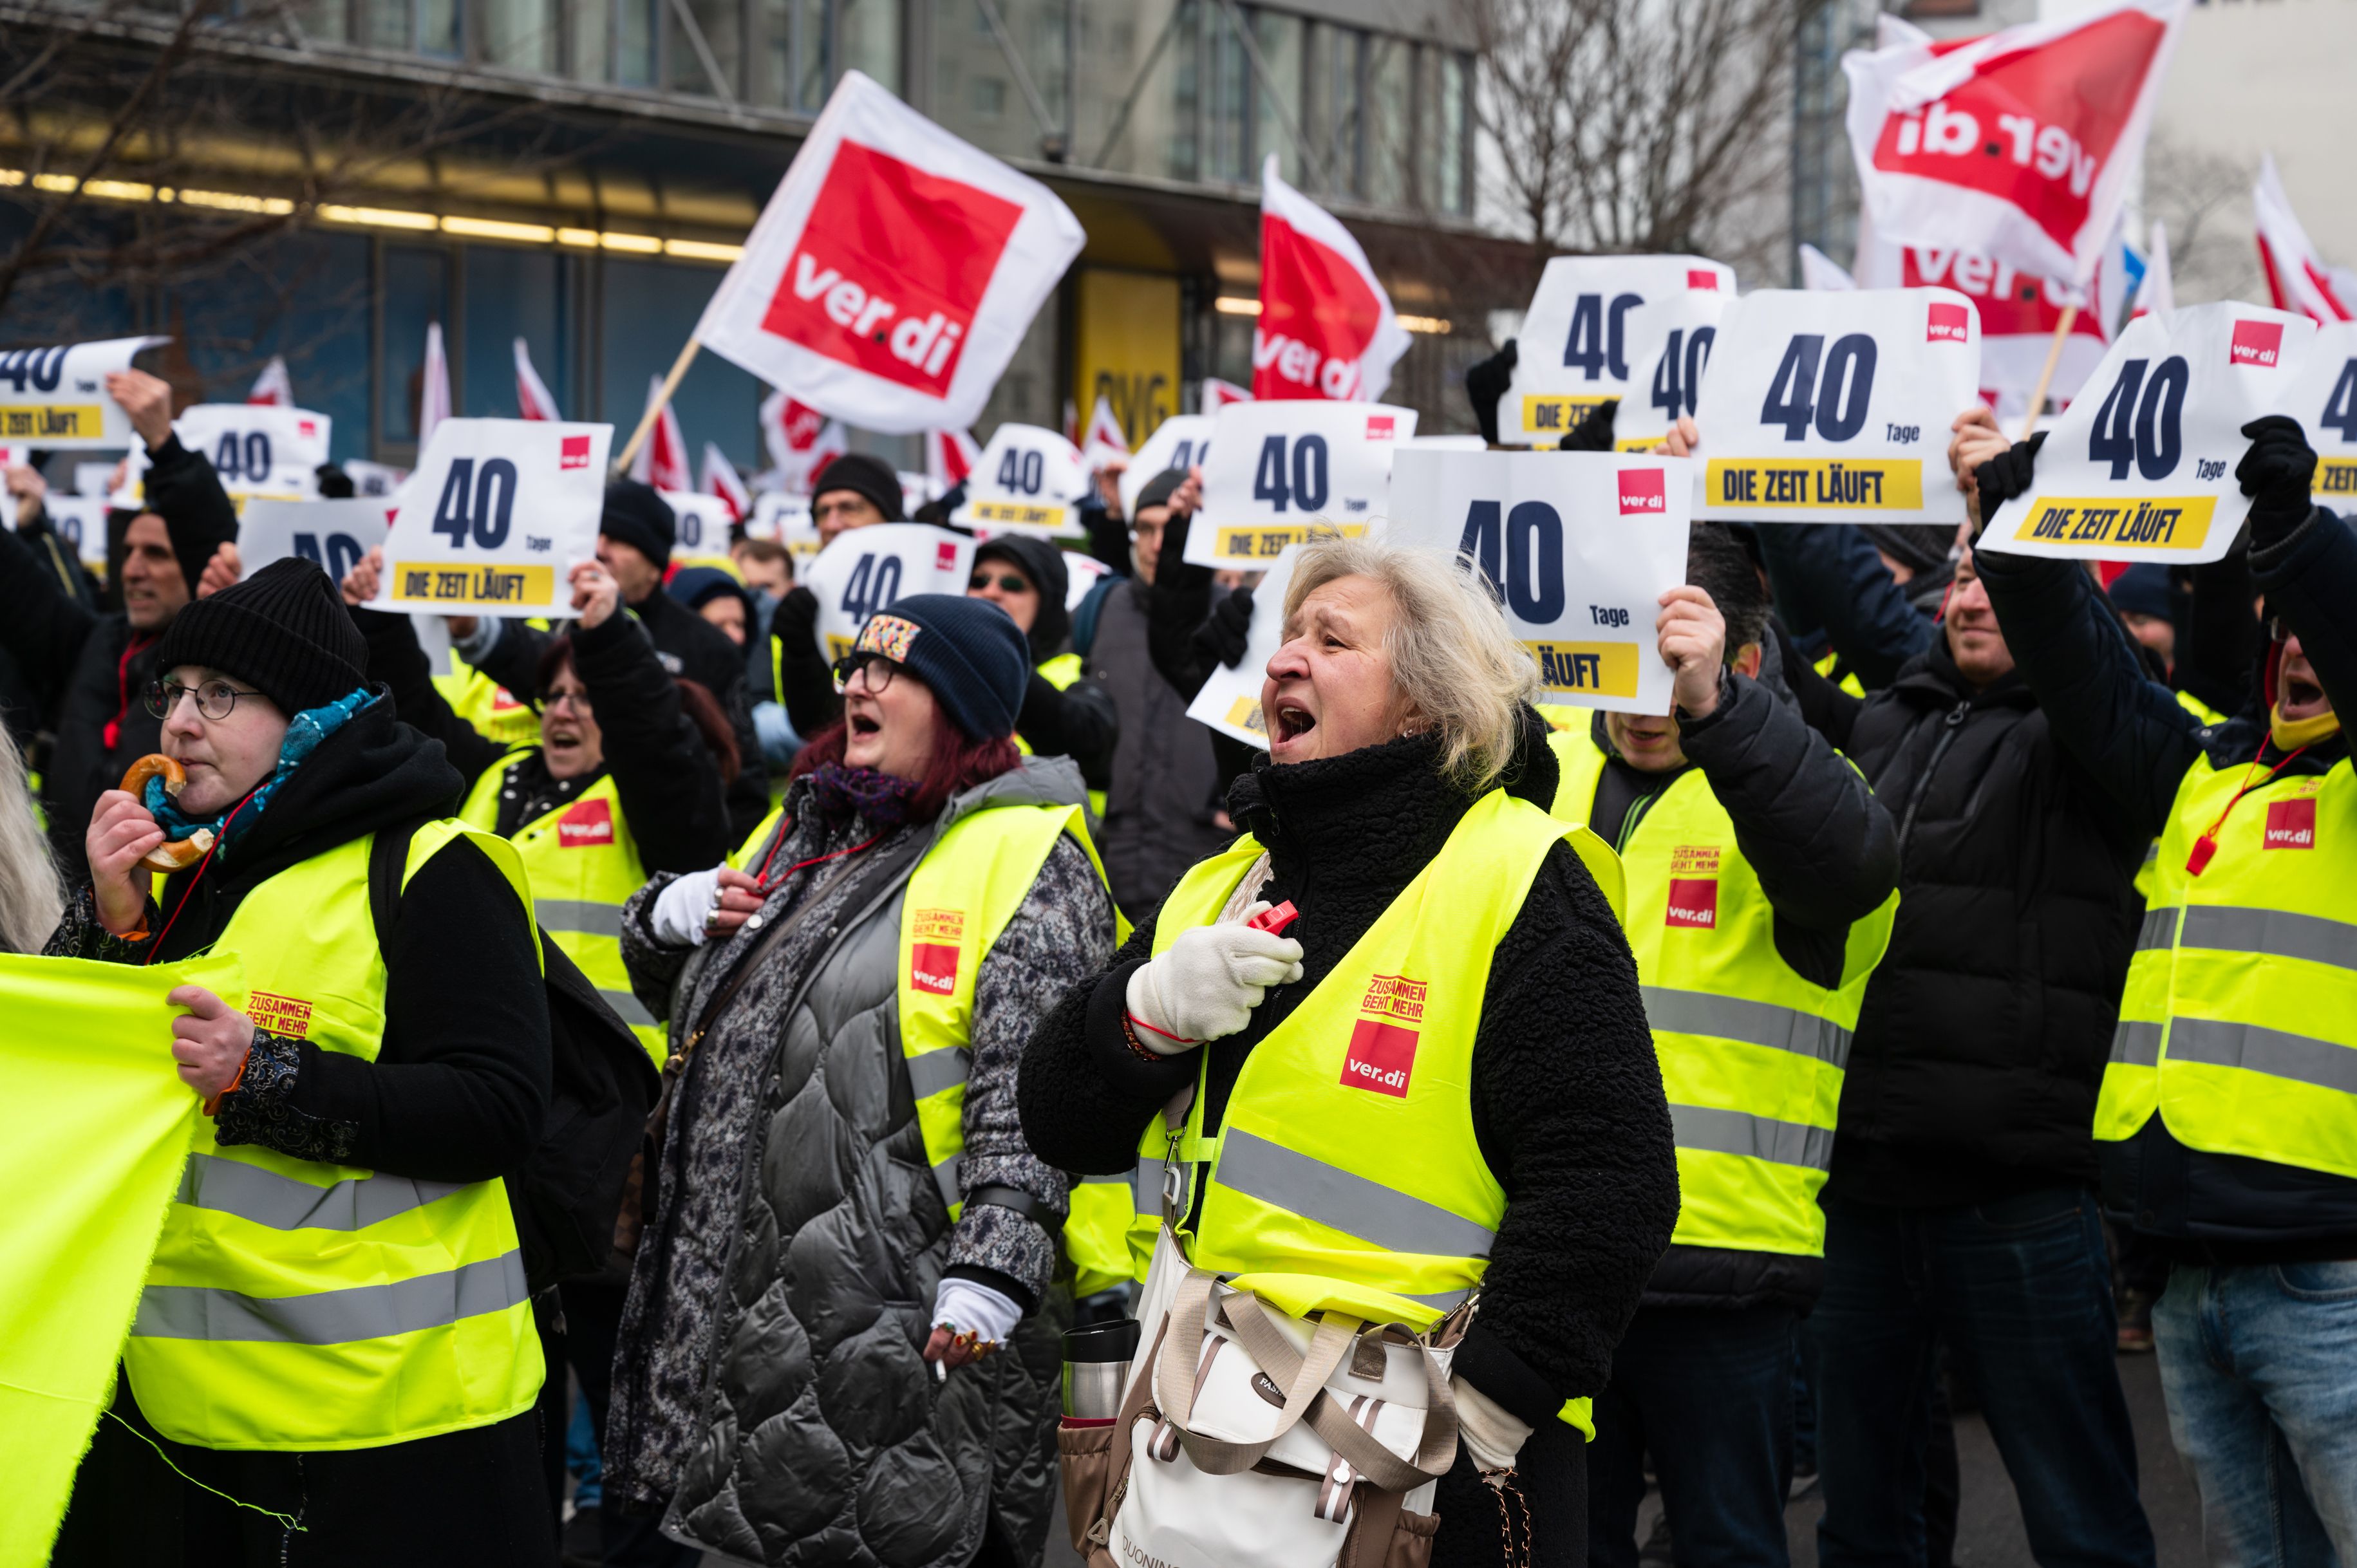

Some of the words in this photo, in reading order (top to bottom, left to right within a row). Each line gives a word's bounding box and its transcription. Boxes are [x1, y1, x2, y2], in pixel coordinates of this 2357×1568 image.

[793, 253, 963, 377] ver.di
[1563, 292, 1645, 381] 40
[1929, 322, 1966, 340] ver.di
[2233, 343, 2276, 364] ver.di
[1760, 333, 1878, 442] 40
[2320, 357, 2357, 443] 4
[1535, 404, 1561, 429] DIE
[1568, 404, 1601, 427] ZE
[2088, 354, 2190, 481] 40
[1886, 422, 1920, 445] Tage
[216, 431, 272, 482] 40
[1170, 440, 1210, 475] 4
[2196, 458, 2226, 482] Tage
[997, 448, 1043, 495] 40
[1254, 433, 1329, 513] 40
[1723, 469, 1757, 502] DIE
[1764, 469, 1809, 503] ZEIT
[1817, 462, 1884, 505] LÄUFT
[431, 457, 518, 550] 40
[1621, 494, 1663, 509] ver.di
[2032, 507, 2076, 539] DIE
[2069, 509, 2118, 541] ZEIT
[2115, 501, 2183, 543] LÄUFT
[1228, 533, 1255, 555] DIE
[1454, 499, 1565, 624] 40
[404, 571, 431, 597] DIE
[435, 572, 469, 599] ZEIT
[474, 567, 526, 601] LÄUFT
[841, 554, 903, 625] 40
[1589, 604, 1629, 628] Tage
[1535, 645, 1601, 689] ÄUFT
[559, 820, 611, 837] ver.di
[2268, 828, 2312, 844] ver.di
[915, 912, 964, 925] ZUSAMMEN
[1669, 906, 1713, 924] ver.di
[939, 924, 963, 936] MEHR
[913, 969, 954, 991] ver.di
[1367, 978, 1427, 1002] ZUSAMMEN
[248, 995, 312, 1020] ZUSAMMEN
[1362, 994, 1391, 1009] GEHT
[1391, 996, 1424, 1018] MEHR
[277, 1016, 309, 1035] MEHR
[1349, 1058, 1406, 1088] ver.di
[1123, 1535, 1179, 1568] DUONI
